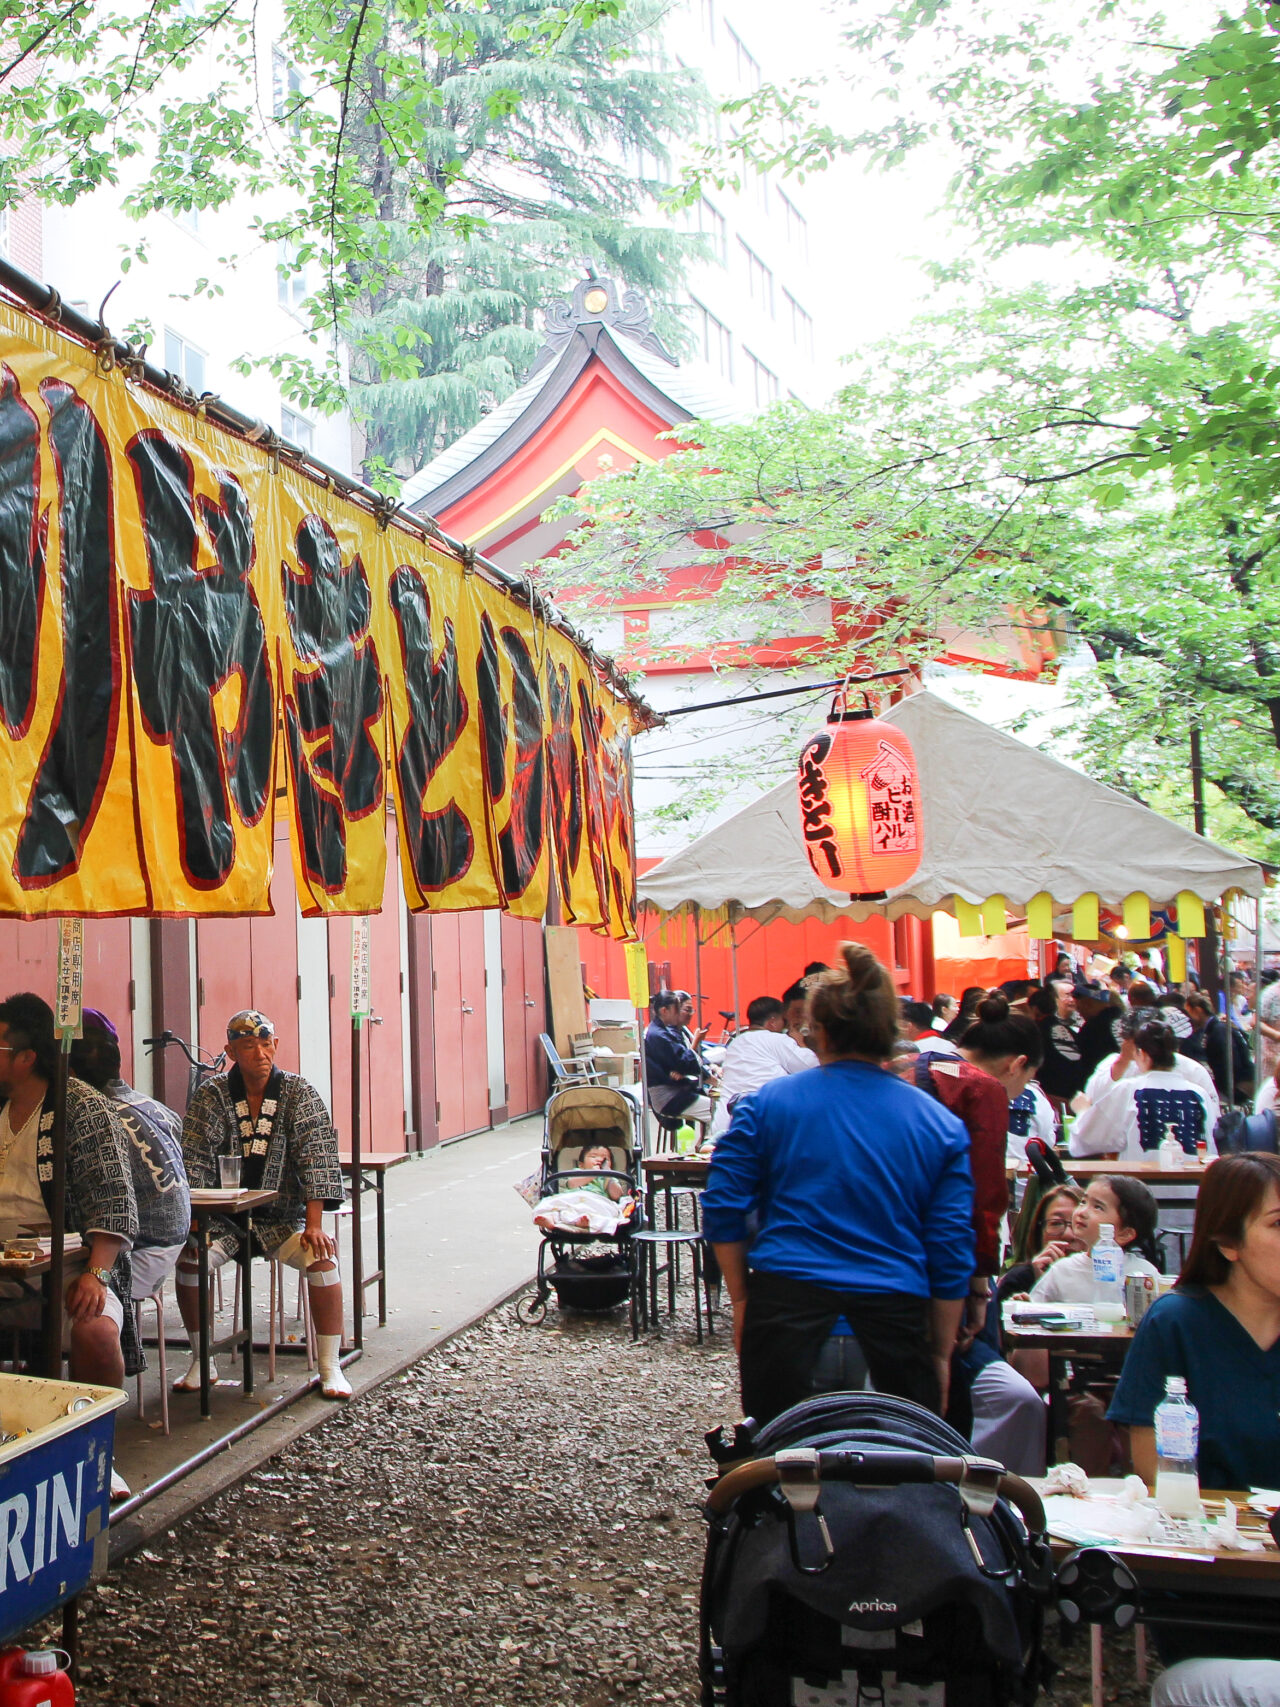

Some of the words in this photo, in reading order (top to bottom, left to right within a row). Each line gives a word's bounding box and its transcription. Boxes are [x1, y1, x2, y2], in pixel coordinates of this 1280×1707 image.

[798, 731, 842, 878] やきとり
[871, 801, 893, 849] 酎ハイ
[888, 788, 905, 839] ビール
[848, 1598, 897, 1613] Aprica
